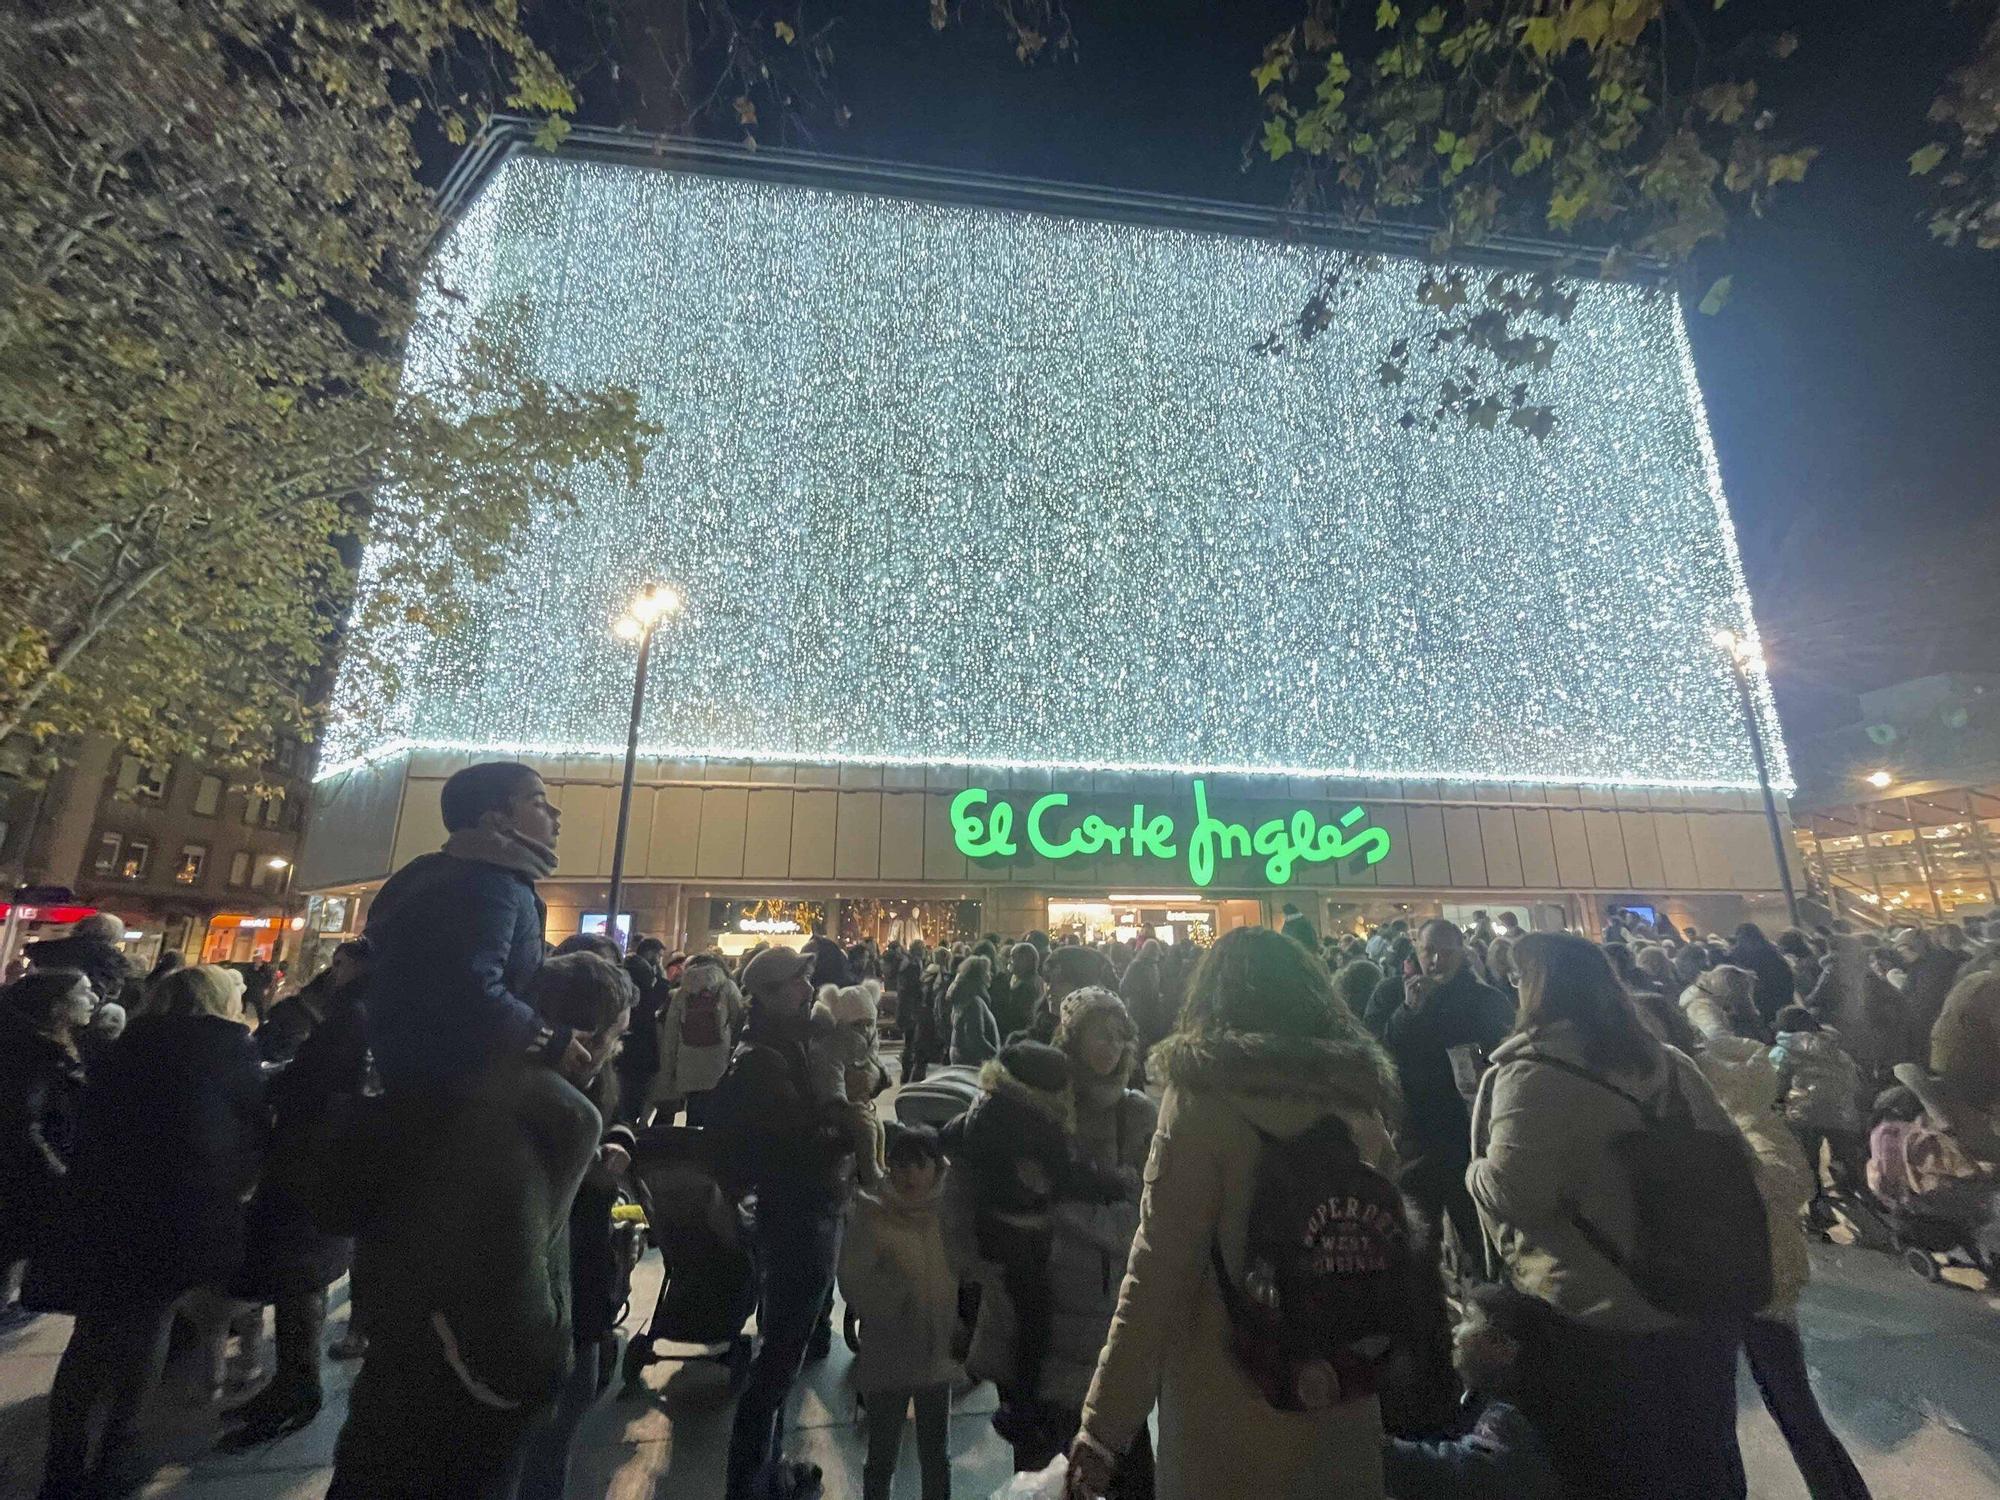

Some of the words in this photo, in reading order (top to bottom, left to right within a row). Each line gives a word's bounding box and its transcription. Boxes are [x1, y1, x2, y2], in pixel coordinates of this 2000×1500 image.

[950, 787, 1017, 858] El
[1027, 793, 1177, 859] Corte
[1188, 779, 1391, 887] Inglés
[1304, 1195, 1402, 1248] UPERD
